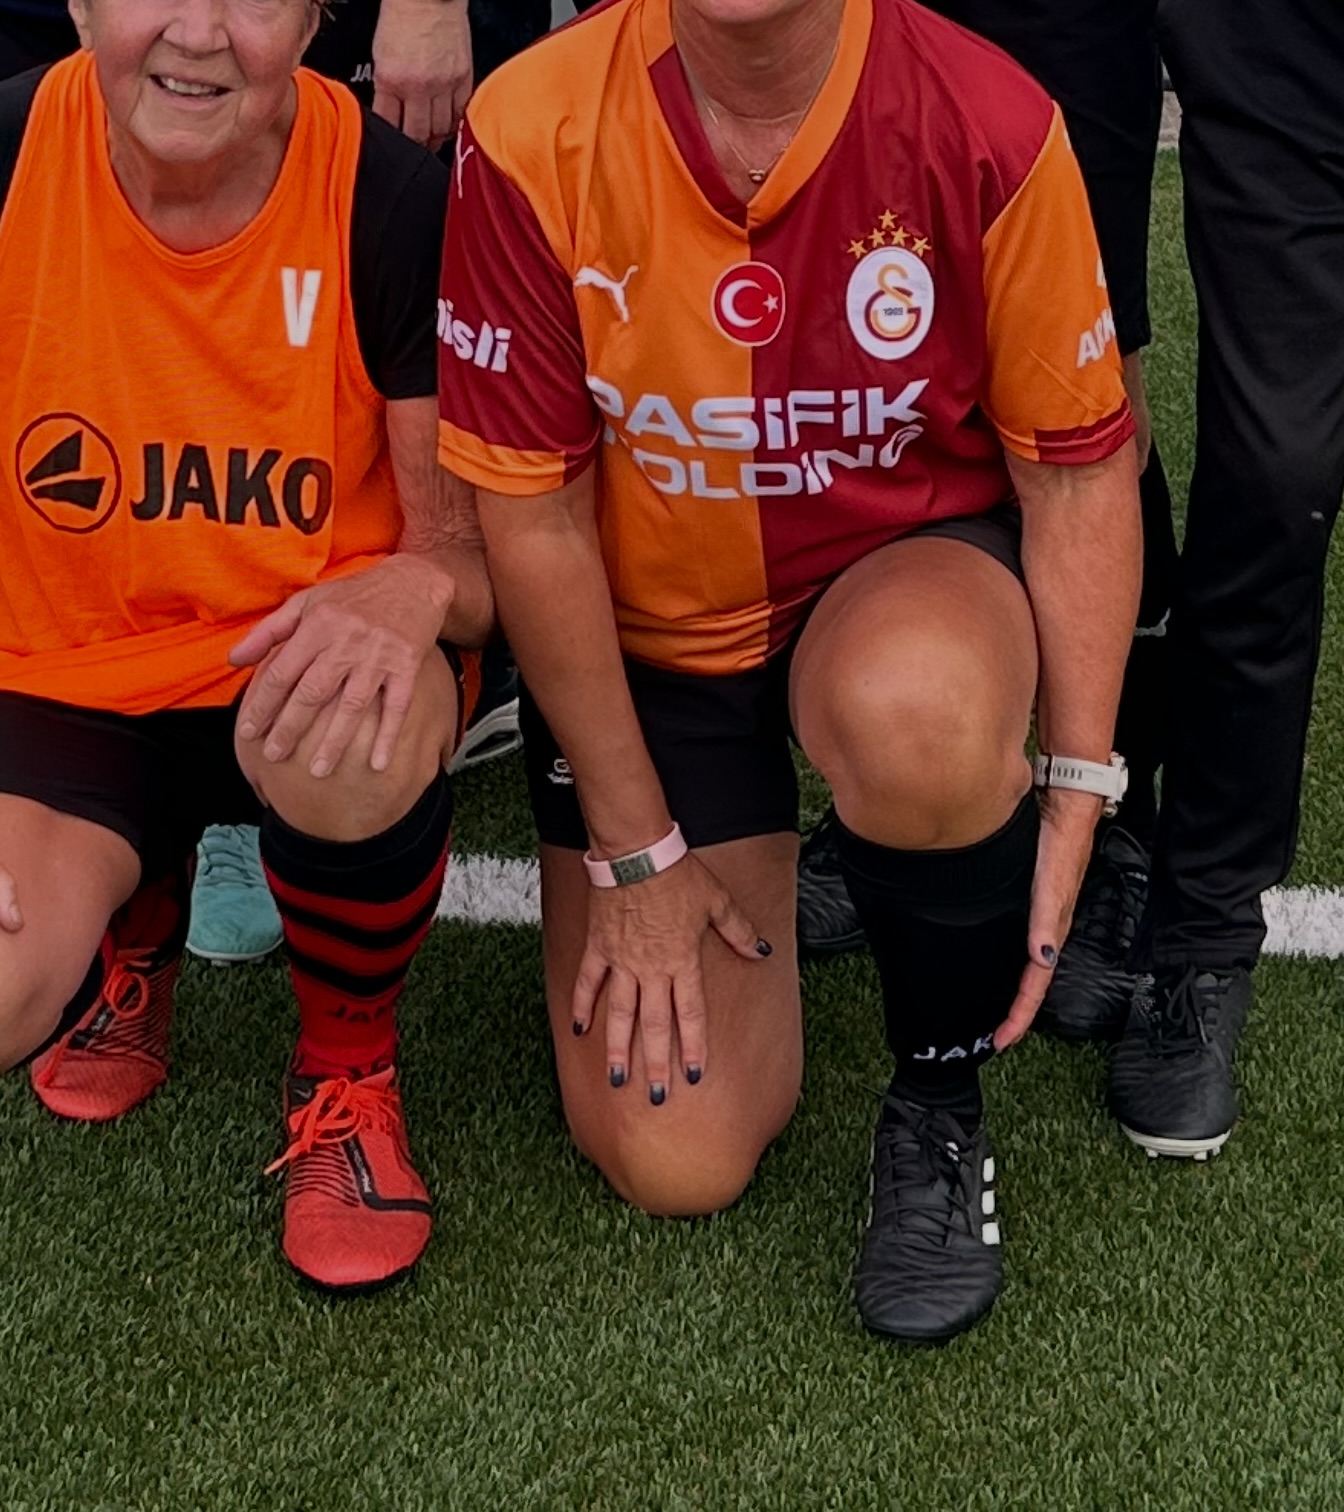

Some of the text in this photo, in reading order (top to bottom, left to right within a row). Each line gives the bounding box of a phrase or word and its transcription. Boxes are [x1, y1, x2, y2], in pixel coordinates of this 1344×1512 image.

[350, 63, 372, 82] JA
[281, 267, 322, 347] V
[130, 442, 333, 535] JAKO
[913, 1033, 994, 1061] JAK
